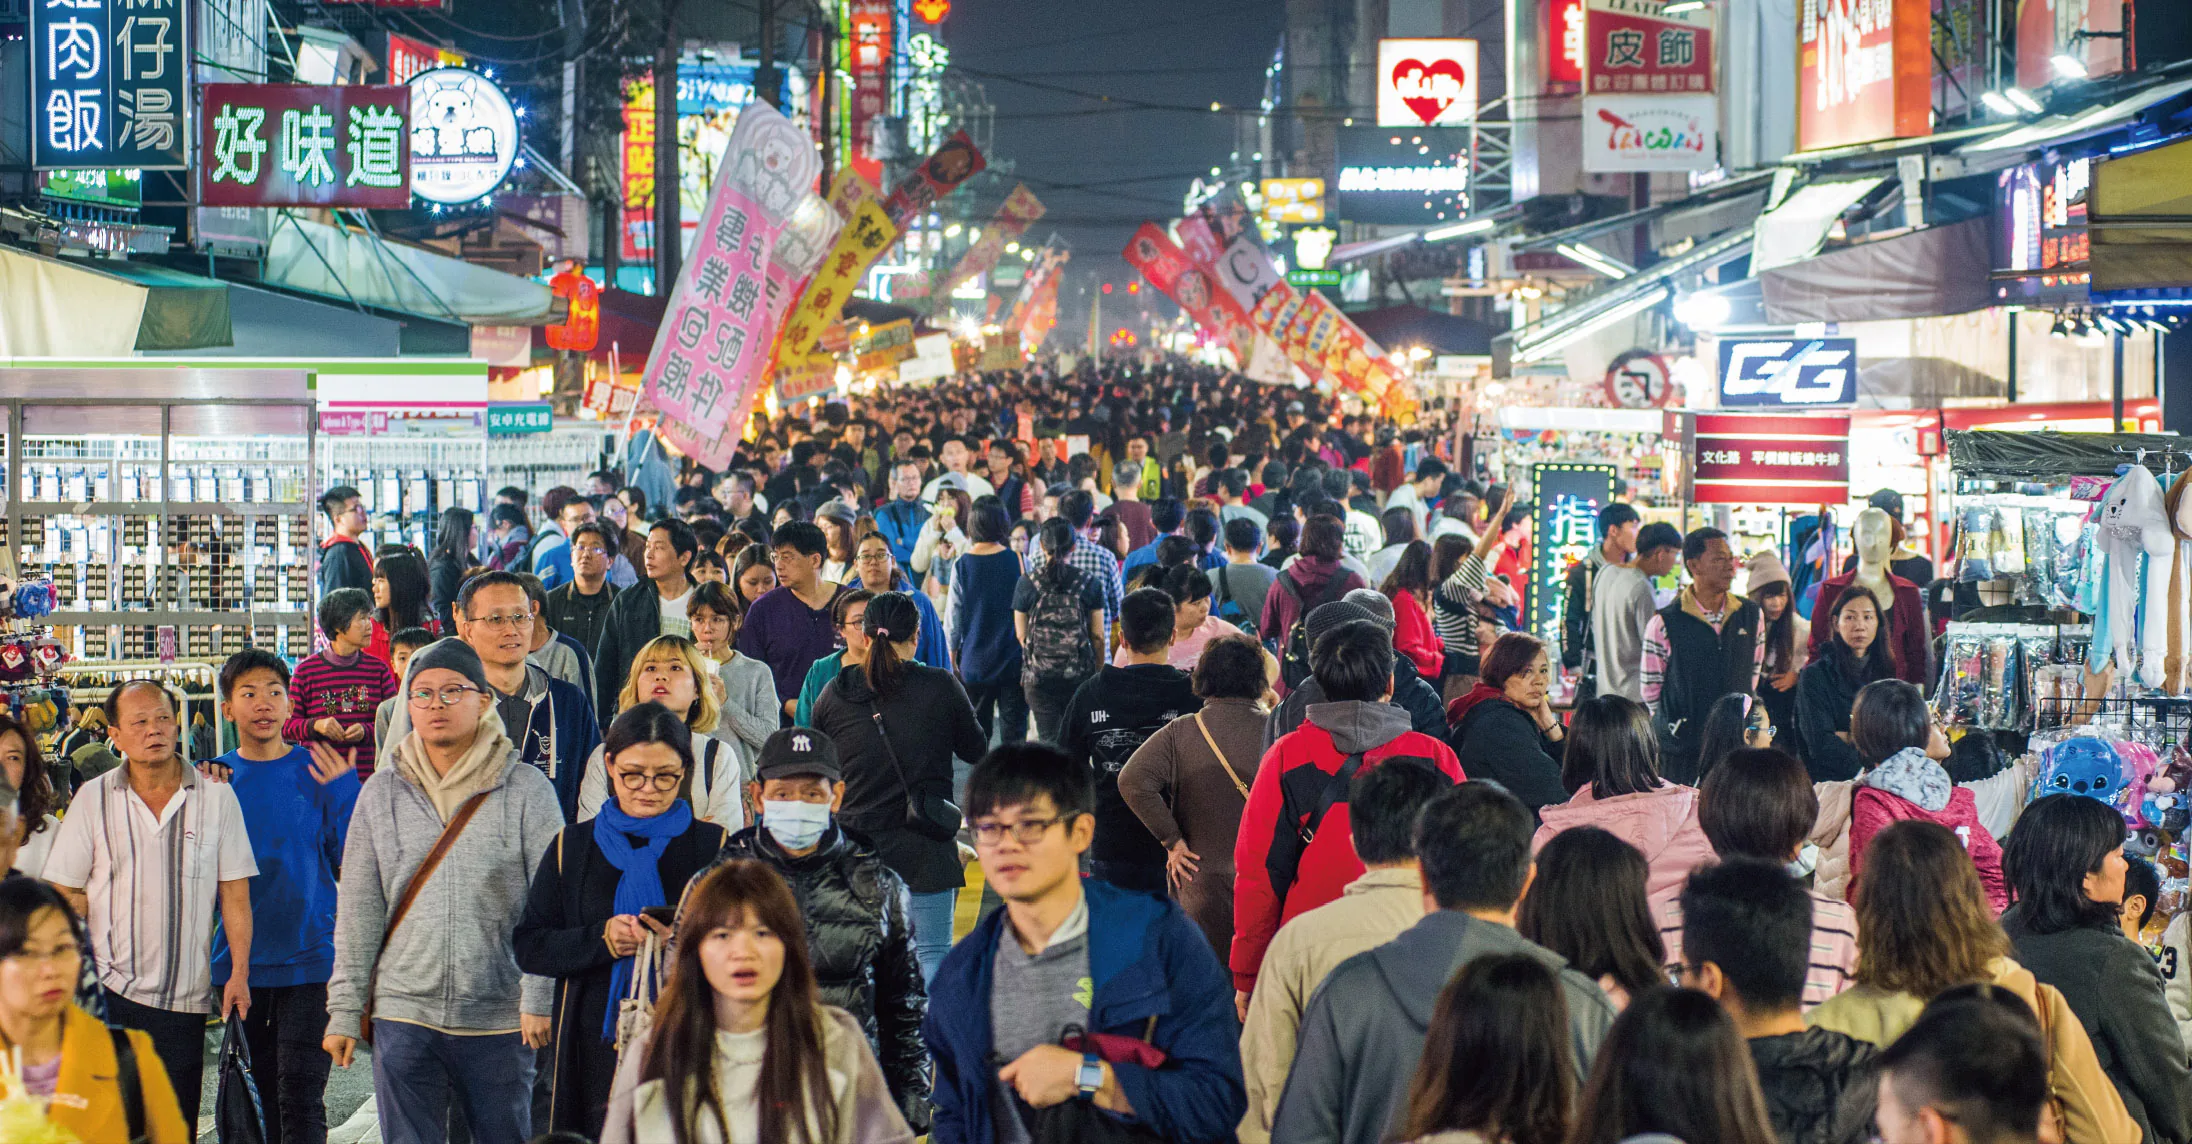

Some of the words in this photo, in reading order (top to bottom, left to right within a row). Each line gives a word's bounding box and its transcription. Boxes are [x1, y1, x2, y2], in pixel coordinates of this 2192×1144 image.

[45, 0, 103, 151] 肉飯
[116, 0, 174, 151] 仔湯
[1606, 30, 1695, 67] 皮飾
[212, 103, 403, 188] 好味道
[1702, 450, 1740, 465] 文化路
